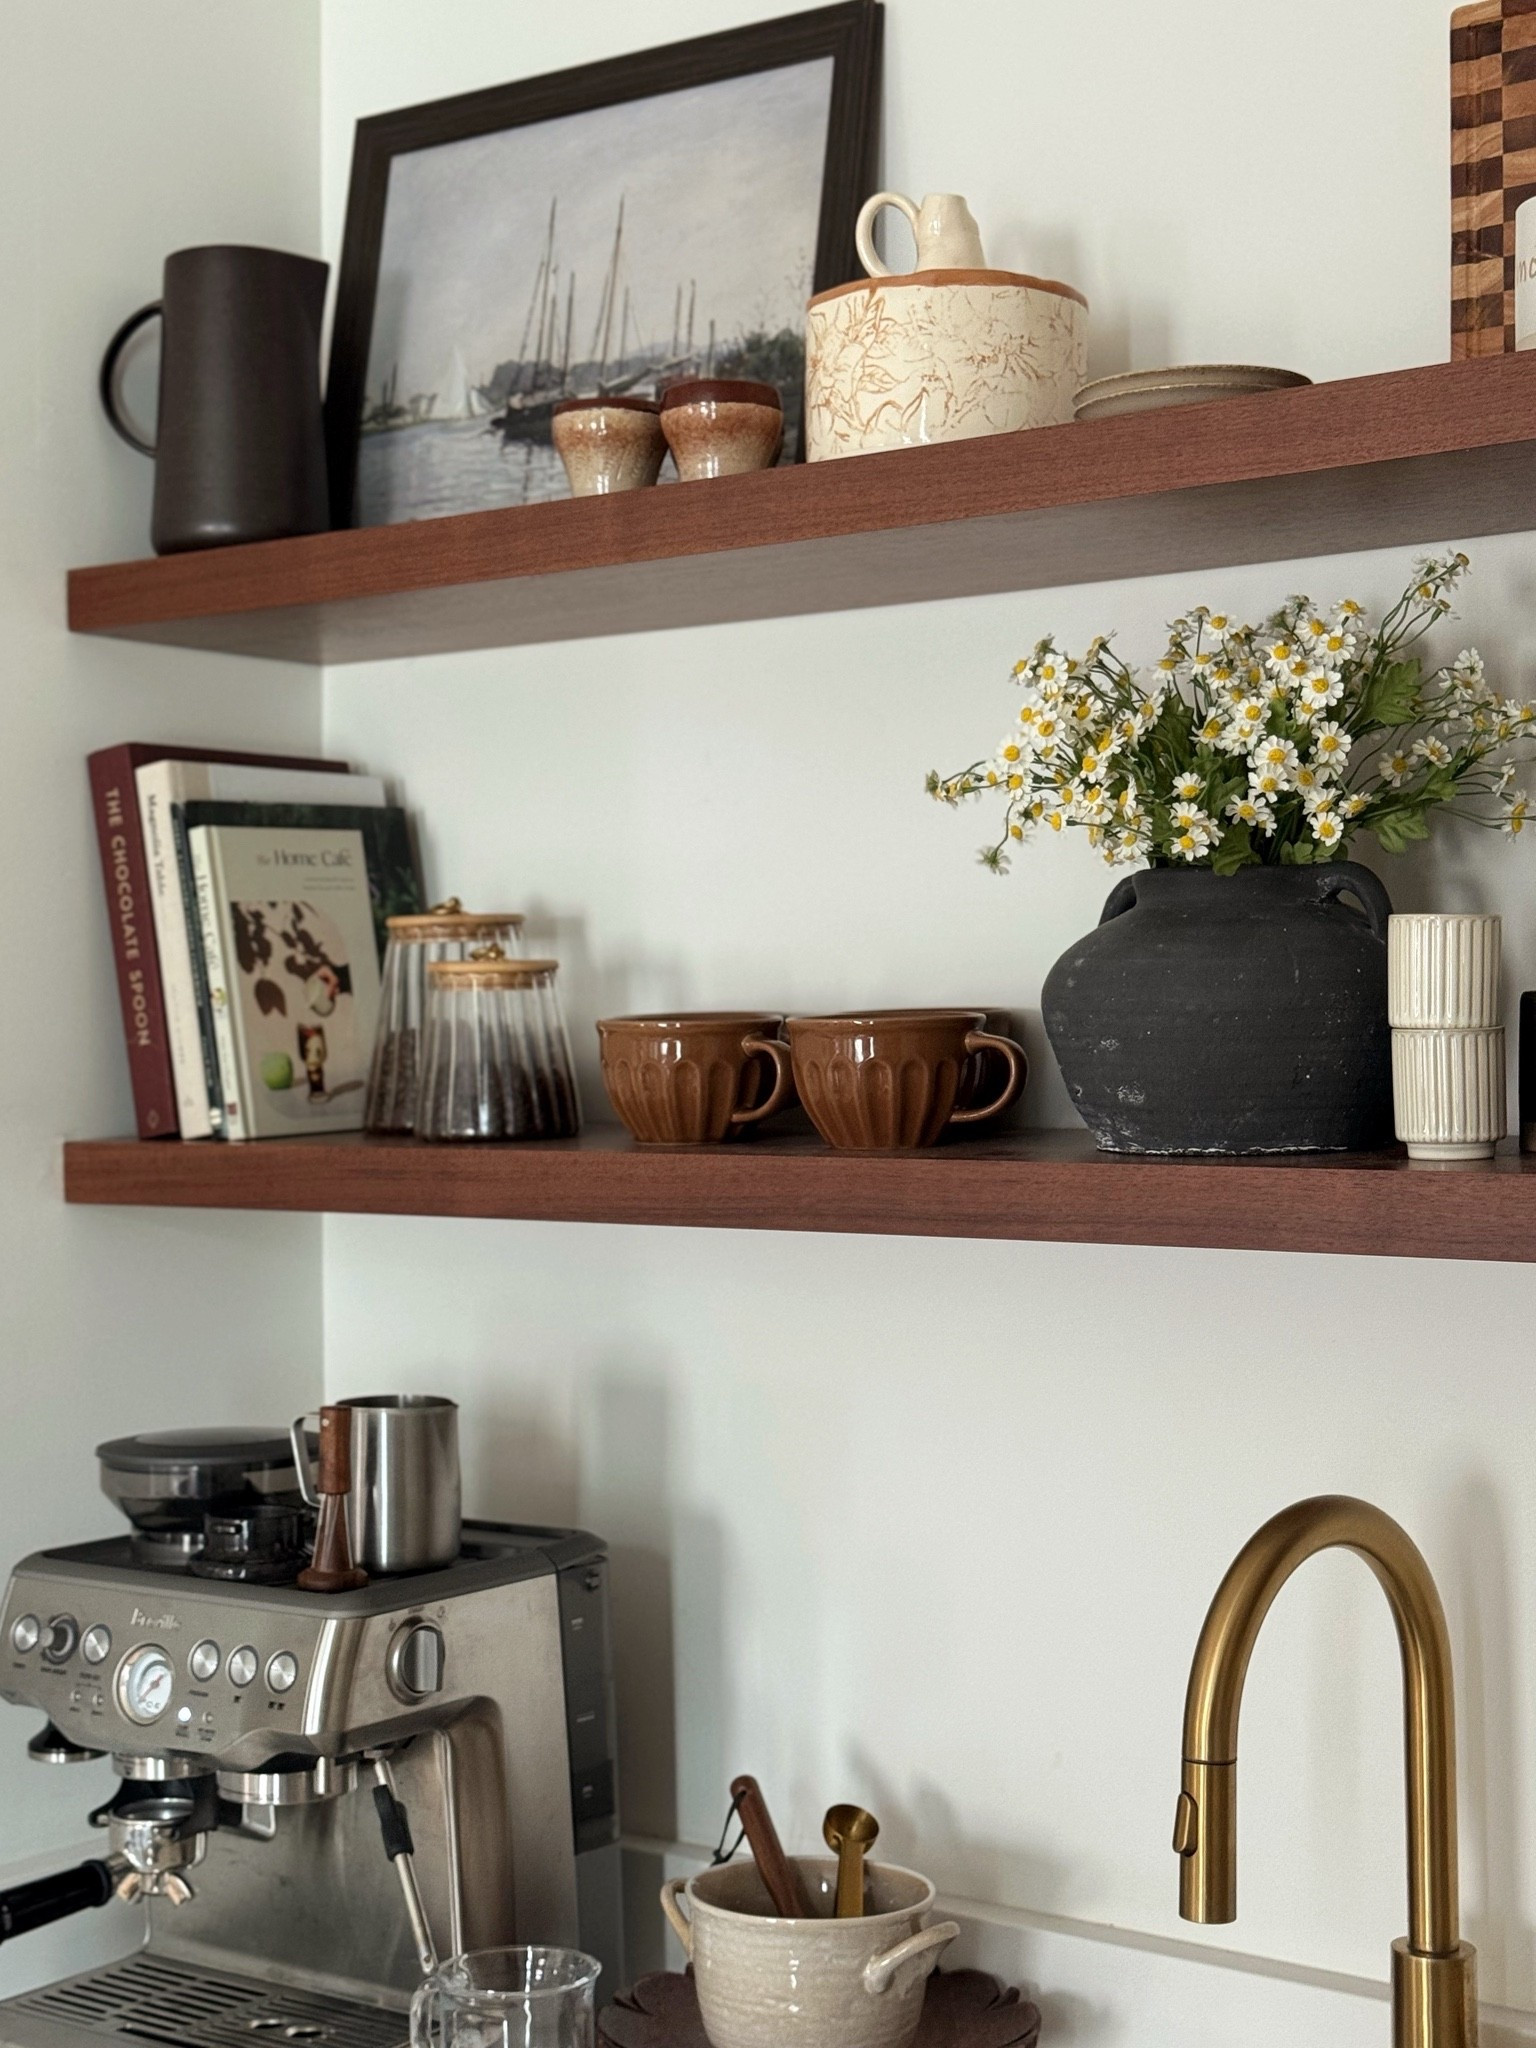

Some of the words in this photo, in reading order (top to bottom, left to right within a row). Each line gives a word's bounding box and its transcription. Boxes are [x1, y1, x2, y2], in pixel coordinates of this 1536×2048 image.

[105, 787, 124, 828] THE
[273, 848, 317, 867] Home
[111, 835, 140, 960] CHOCOLATE
[128, 969, 151, 1047] SPOON
